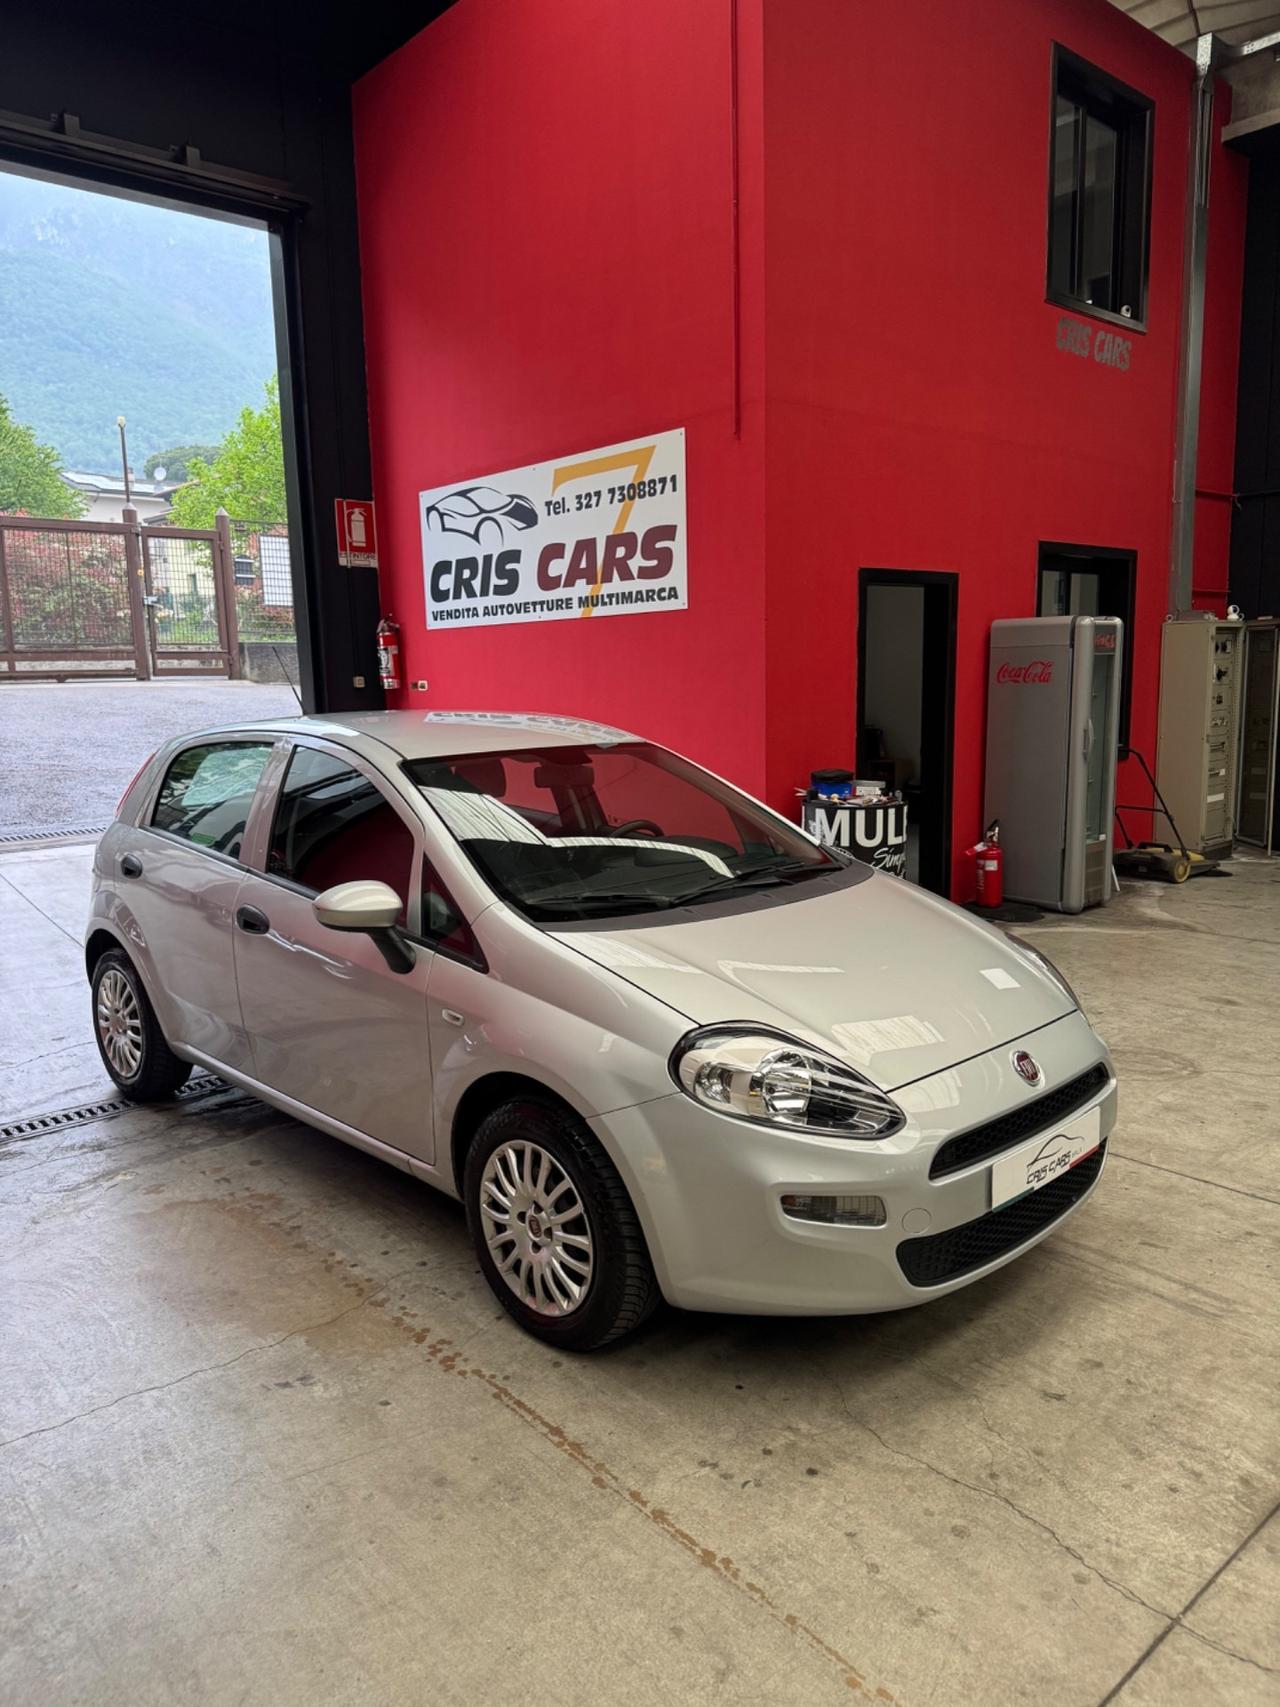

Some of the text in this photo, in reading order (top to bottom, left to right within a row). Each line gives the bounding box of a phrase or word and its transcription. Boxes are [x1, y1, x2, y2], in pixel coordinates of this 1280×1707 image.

[1056, 316, 1132, 371] CRIS CARS
[544, 474, 678, 517] Tel. 327 7308871
[430, 524, 678, 603] CRIS CARS
[432, 586, 679, 622] VENDITA AUTOVETTURE MULTIMARCA
[1026, 1164, 1049, 1185] CRIS
[1049, 1150, 1071, 1173] CARS
